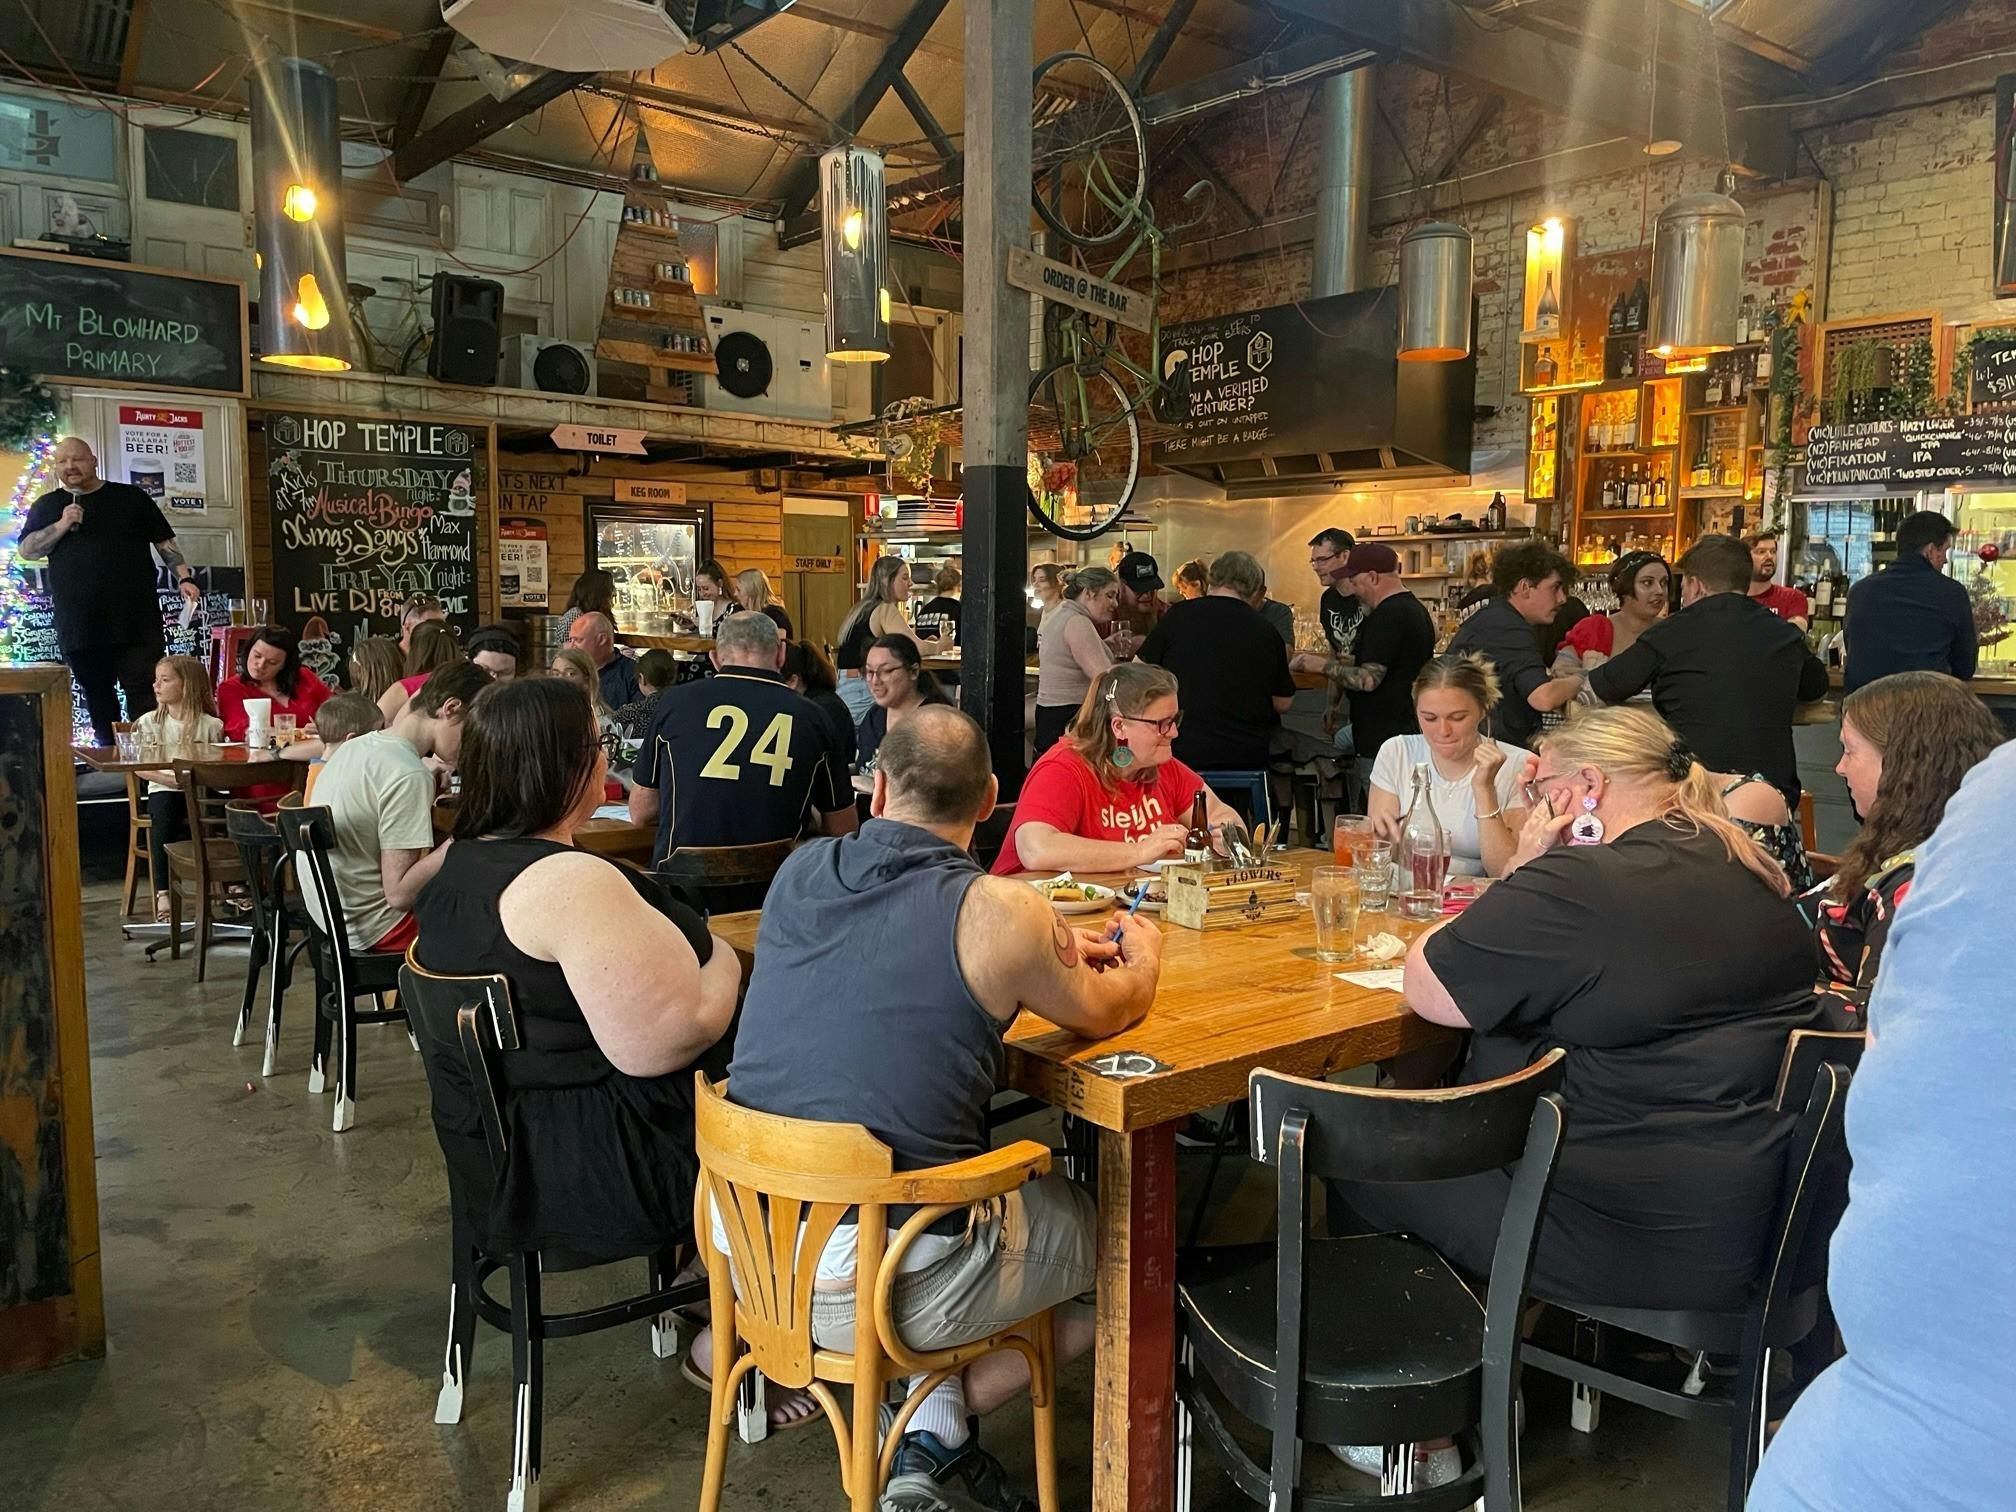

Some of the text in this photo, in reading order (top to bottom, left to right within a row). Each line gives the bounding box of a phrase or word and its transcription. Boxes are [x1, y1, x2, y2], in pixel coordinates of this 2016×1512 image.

[1043, 267, 1127, 312] ORDER @ THE BAR
[78, 306, 199, 344] BLOWHARD
[66, 342, 162, 376] PRIMARY
[1192, 341, 1224, 365] HOP
[1204, 389, 1213, 402] A
[1218, 376, 1269, 399] VERIFIED
[1190, 396, 1255, 417] VENTURER?
[1198, 419, 1215, 428] OUT
[1217, 417, 1228, 425] ON
[303, 418, 444, 455] HOP TEMPLE
[586, 432, 617, 446] TOILET
[1192, 434, 1215, 447] MIGHT
[1218, 433, 1229, 444] BE
[1232, 434, 1239, 443] A
[1808, 425, 1830, 442] (VIC)
[126, 443, 168, 454] BEER!
[1807, 441, 1828, 458] (NZ)
[1829, 437, 1880, 454] PANHEAD
[1920, 440, 1940, 450] XPA
[1807, 456, 1828, 473] (VIC)
[1828, 450, 1886, 469] FIXATION
[1912, 451, 1932, 462] IPA
[317, 459, 455, 491] THURSDAY
[529, 474, 568, 491] NEXT
[1806, 470, 1827, 486] (VIC)
[1915, 467, 1936, 478] STEP
[517, 494, 548, 512] TAP
[630, 486, 671, 499] KEG ROOM
[306, 484, 434, 533] Musical Bingo
[430, 514, 461, 535] Max
[421, 531, 471, 562] Hammond
[500, 553, 524, 561] EER!
[795, 557, 831, 569] STAFF ONLY
[294, 586, 376, 613] LIVE DJ
[377, 588, 405, 600] FROM
[379, 600, 403, 618] 8P
[699, 704, 794, 787] 24
[1101, 794, 1162, 831] sleigh
[1226, 869, 1282, 886] FLOWERS
